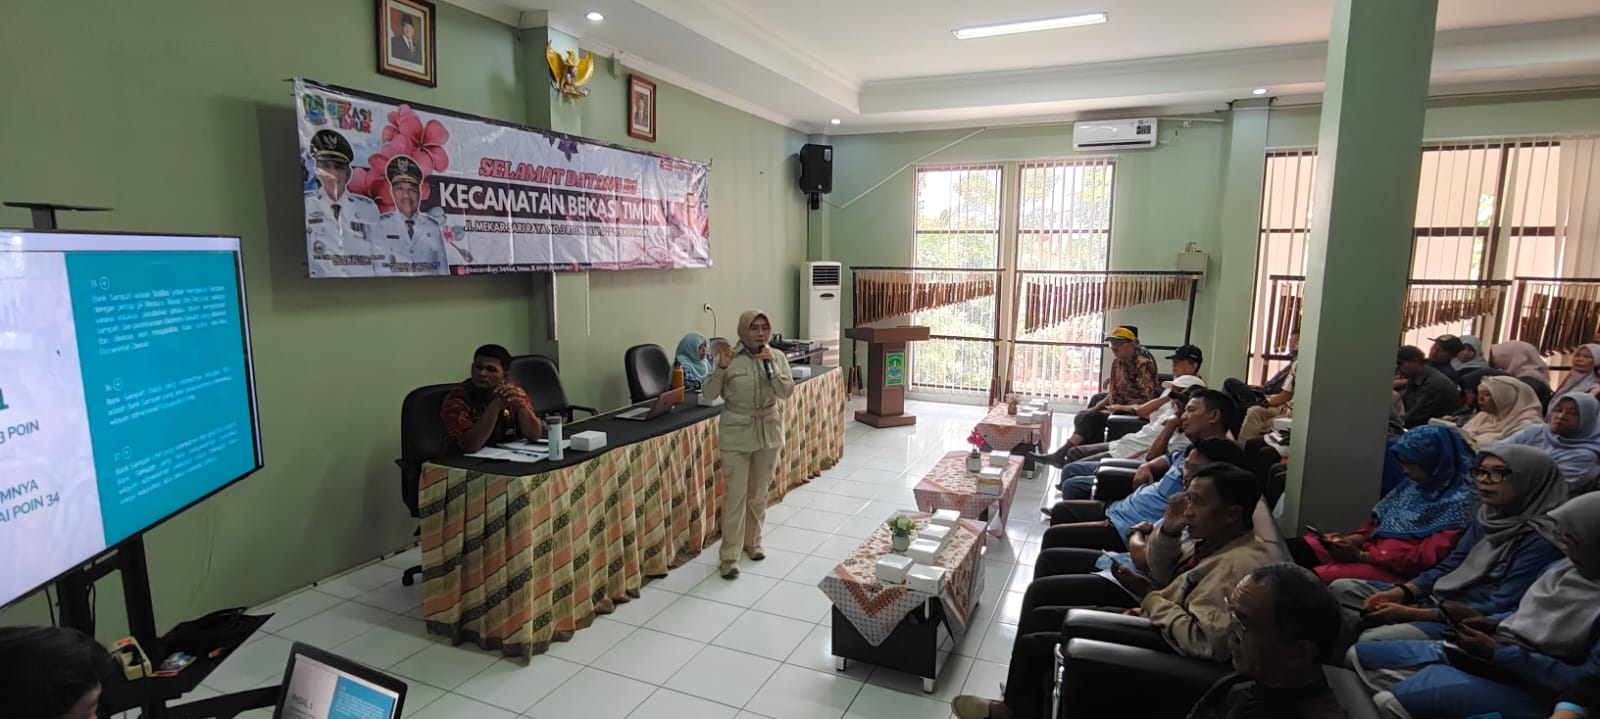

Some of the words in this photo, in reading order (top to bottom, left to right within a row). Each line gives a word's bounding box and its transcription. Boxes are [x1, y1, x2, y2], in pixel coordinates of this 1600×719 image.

[479, 157, 565, 186] SELAMAT
[440, 182, 565, 216] KECAMATAN
[568, 195, 617, 219] BEKAS
[621, 201, 659, 222] TIMUR
[8, 419, 40, 439] POIN
[13, 495, 44, 519] POIN
[46, 491, 60, 508] 34
